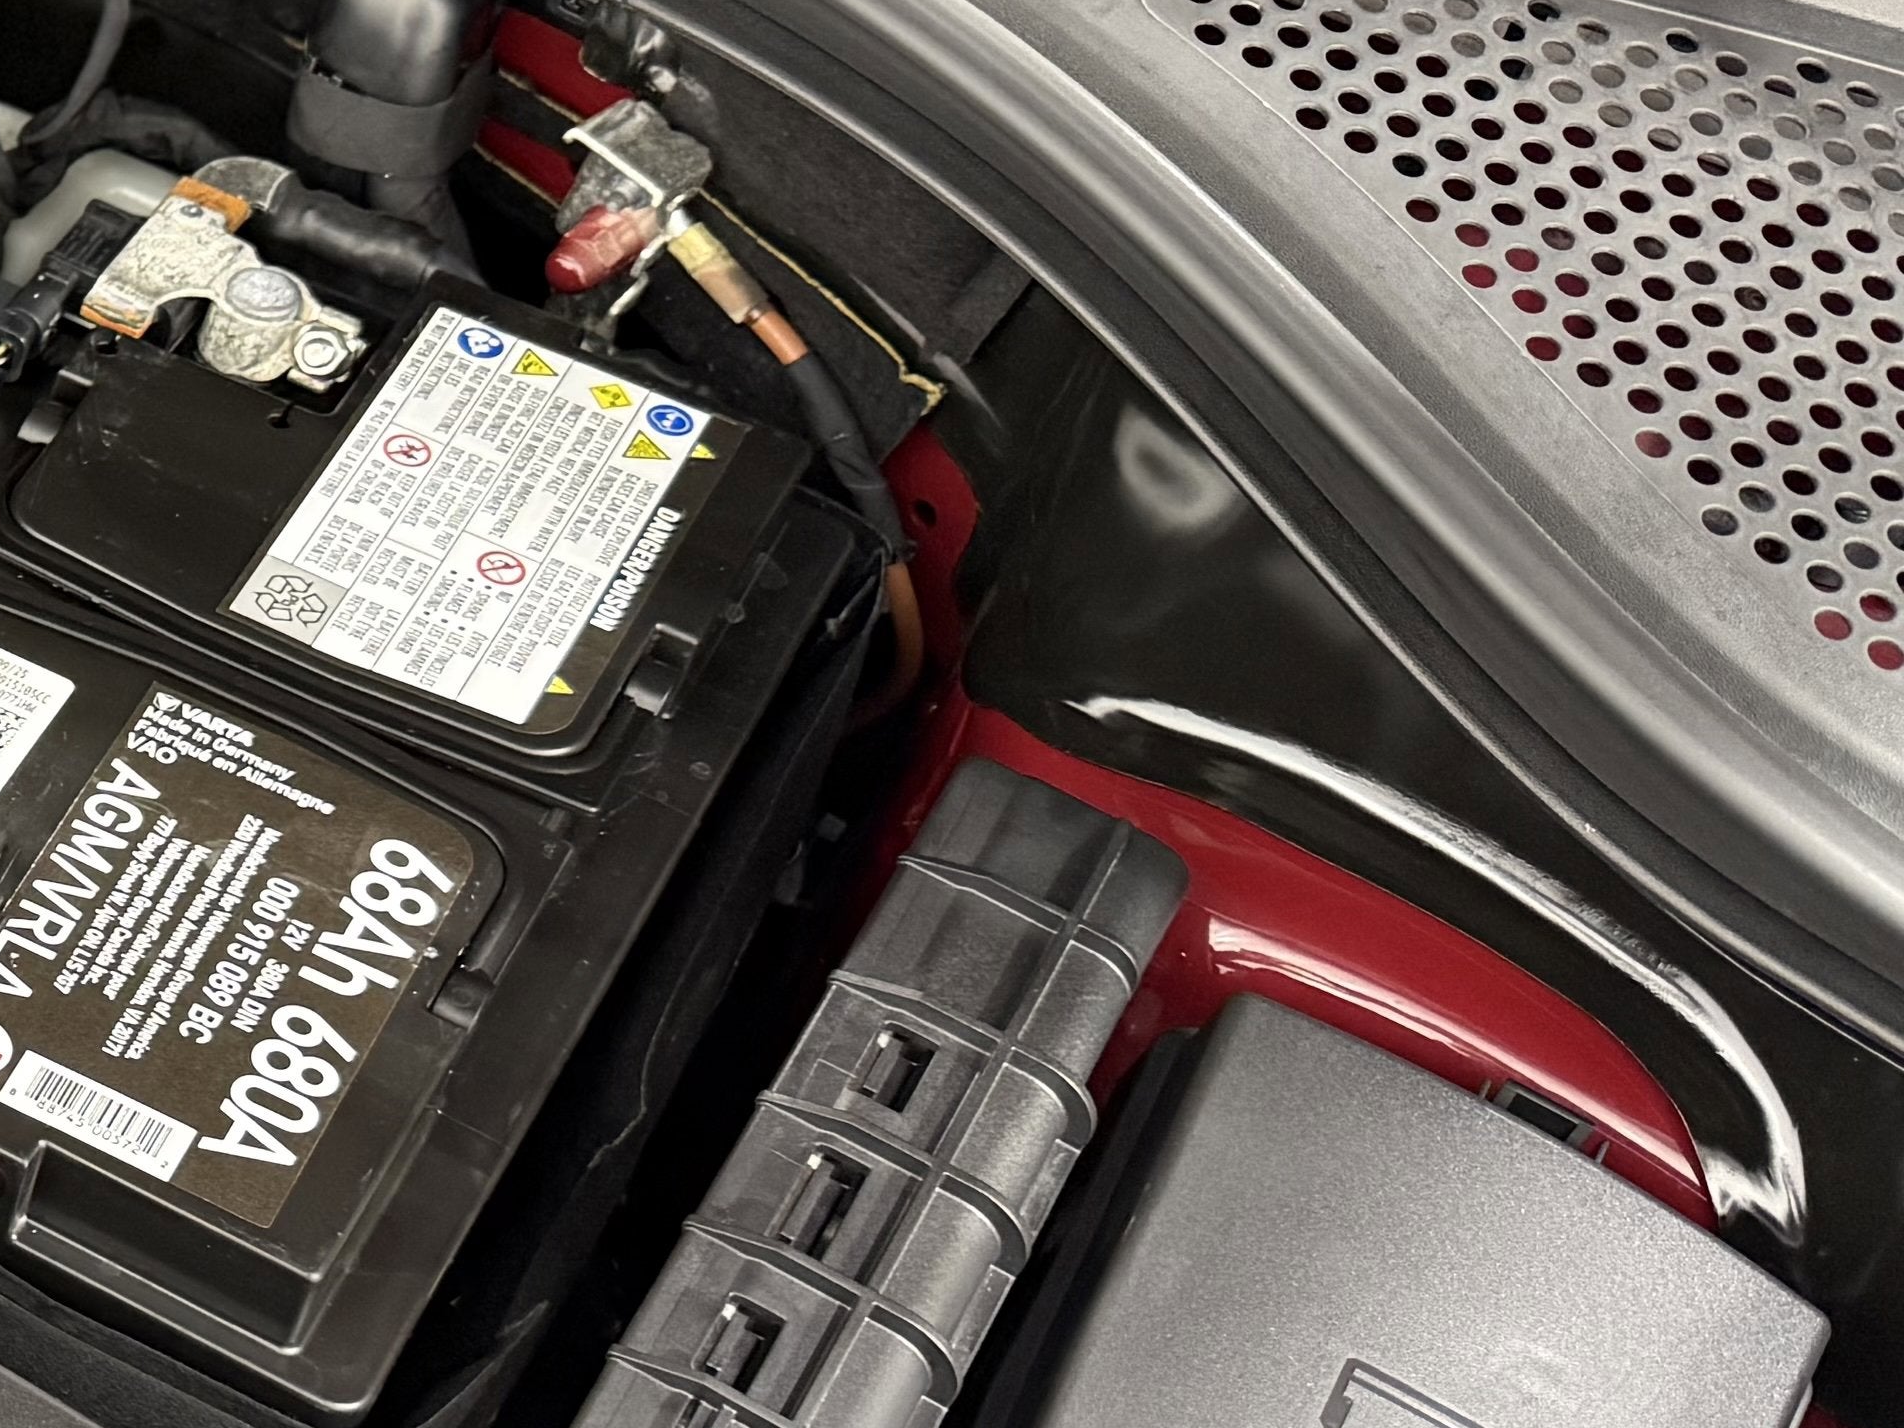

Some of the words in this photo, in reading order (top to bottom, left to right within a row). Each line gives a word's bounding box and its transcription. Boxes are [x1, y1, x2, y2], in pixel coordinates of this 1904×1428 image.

[587, 504, 682, 634] DANGER/POISON
[143, 706, 192, 735] Made
[192, 728, 211, 744] in
[213, 738, 296, 781] Germany
[182, 703, 255, 747] VARTA
[127, 732, 183, 764] VAO
[130, 719, 212, 762] Fabriqué
[212, 757, 237, 773] en
[237, 766, 335, 814] Allemagne
[153, 815, 178, 837] 777
[132, 832, 166, 863] Bayly
[139, 833, 191, 897] Volkswagen
[204, 840, 249, 891] Woodland
[227, 824, 283, 897] Manufactured
[115, 860, 148, 893] Street
[156, 845, 213, 915] Manufactured
[91, 904, 118, 930] Ajax
[117, 896, 152, 928] Group
[184, 887, 219, 920] Pointe
[218, 894, 241, 911] for
[253, 878, 300, 922] 000
[298, 839, 455, 996] 68Ah
[95, 927, 132, 966] Canada
[117, 911, 169, 975] for/Fabriqué
[180, 905, 232, 971] Volkswagen
[227, 919, 274, 965] 915
[281, 919, 314, 951] 12V
[103, 971, 127, 1000] pour
[159, 967, 194, 1003] Group
[202, 961, 249, 1007] 089
[249, 959, 289, 998] 380A
[119, 1008, 145, 1024] VA
[153, 1002, 171, 1018] of
[179, 1003, 224, 1043] BC
[231, 998, 267, 1032] DIN
[102, 1022, 133, 1056] 20171
[198, 994, 357, 1166] 680A
[90, 1124, 142, 1155] 00572
